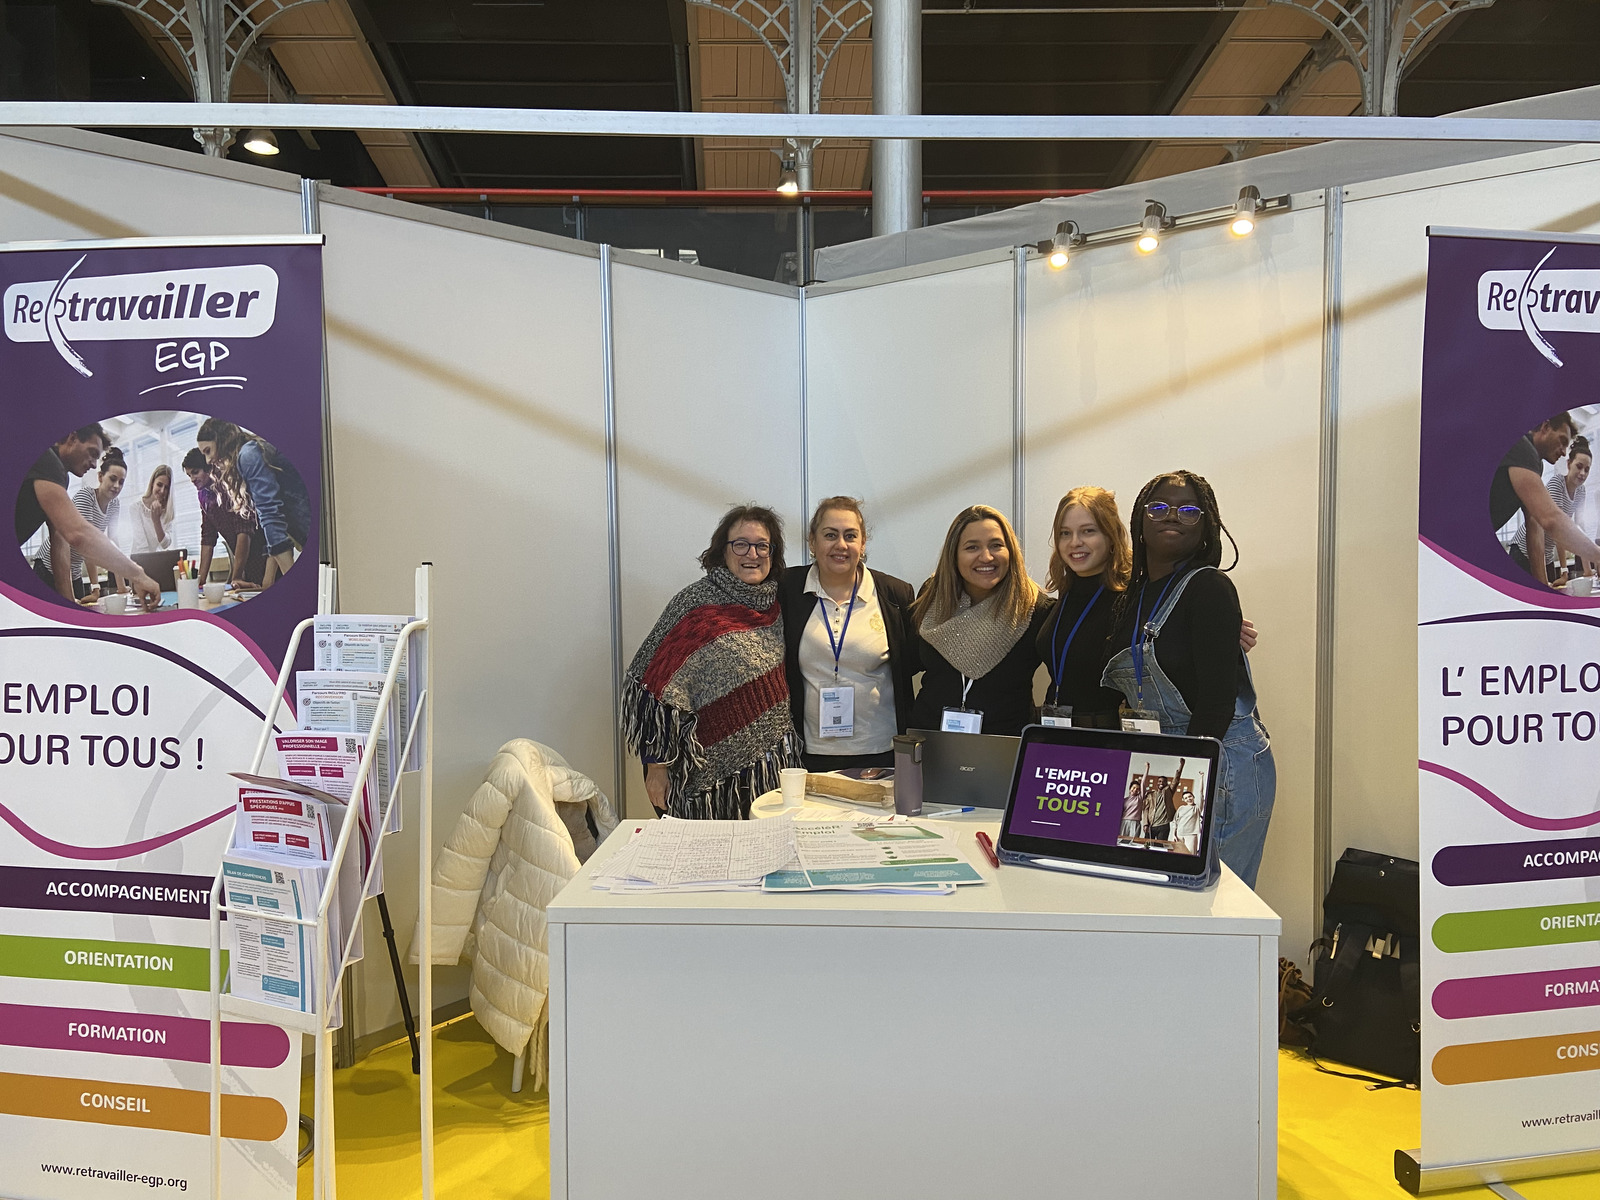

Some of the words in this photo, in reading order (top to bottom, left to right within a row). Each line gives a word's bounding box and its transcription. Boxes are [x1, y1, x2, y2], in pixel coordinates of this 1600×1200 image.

[155, 341, 230, 376] EGP
[4, 683, 149, 716] EMPLOI
[1443, 713, 1543, 746] POUR
[1552, 711, 1600, 741] TO
[81, 735, 181, 769] TOUS
[196, 738, 203, 770] !
[1035, 767, 1108, 785] L'EMPLOI
[1045, 782, 1092, 798] POUR
[1036, 796, 1090, 815] TOUS
[1094, 802, 1102, 816] !
[1523, 850, 1600, 868] ACCOMPA
[46, 881, 210, 905] ACCOMPAGNEMENT
[64, 950, 174, 971] ORIENTATION
[1545, 980, 1600, 997] FORMA
[68, 1022, 166, 1044] FORMATION
[80, 1092, 151, 1113] CONSEIL
[41, 1163, 188, 1191] www.retravailler-egp.org
